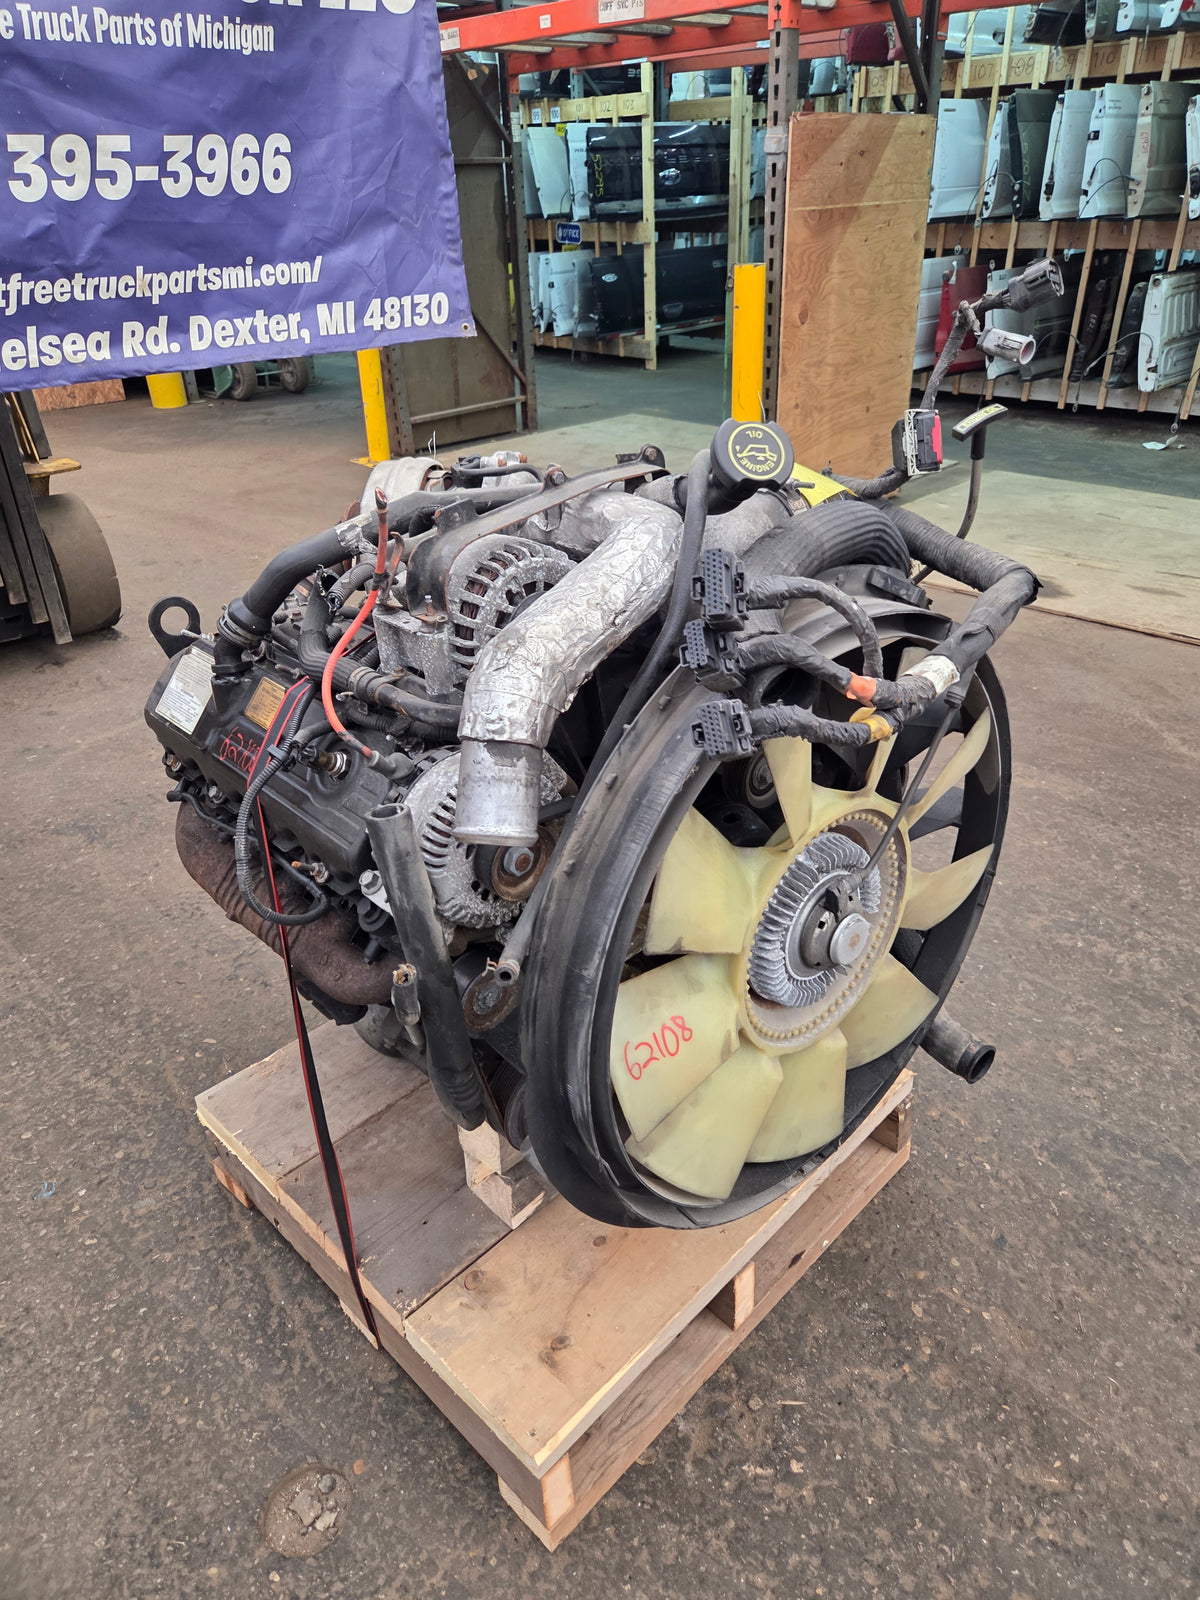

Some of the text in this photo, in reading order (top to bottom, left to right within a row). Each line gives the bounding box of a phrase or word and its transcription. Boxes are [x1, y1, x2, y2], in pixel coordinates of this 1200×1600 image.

[16, 3, 91, 43] Truck
[93, 7, 157, 46] Parts
[161, 13, 182, 47] of
[186, 13, 274, 55] Michigan
[974, 63, 993, 79] 107
[1093, 51, 1115, 67] 110
[6, 133, 292, 202] 395-3966
[122, 315, 181, 358] Rd.
[189, 309, 310, 351] Dexter,
[316, 300, 355, 336] MI
[363, 291, 449, 331] 48130
[745, 430, 763, 439] OIL
[740, 457, 775, 473] ENGINE
[624, 1015, 693, 1081] 62108
